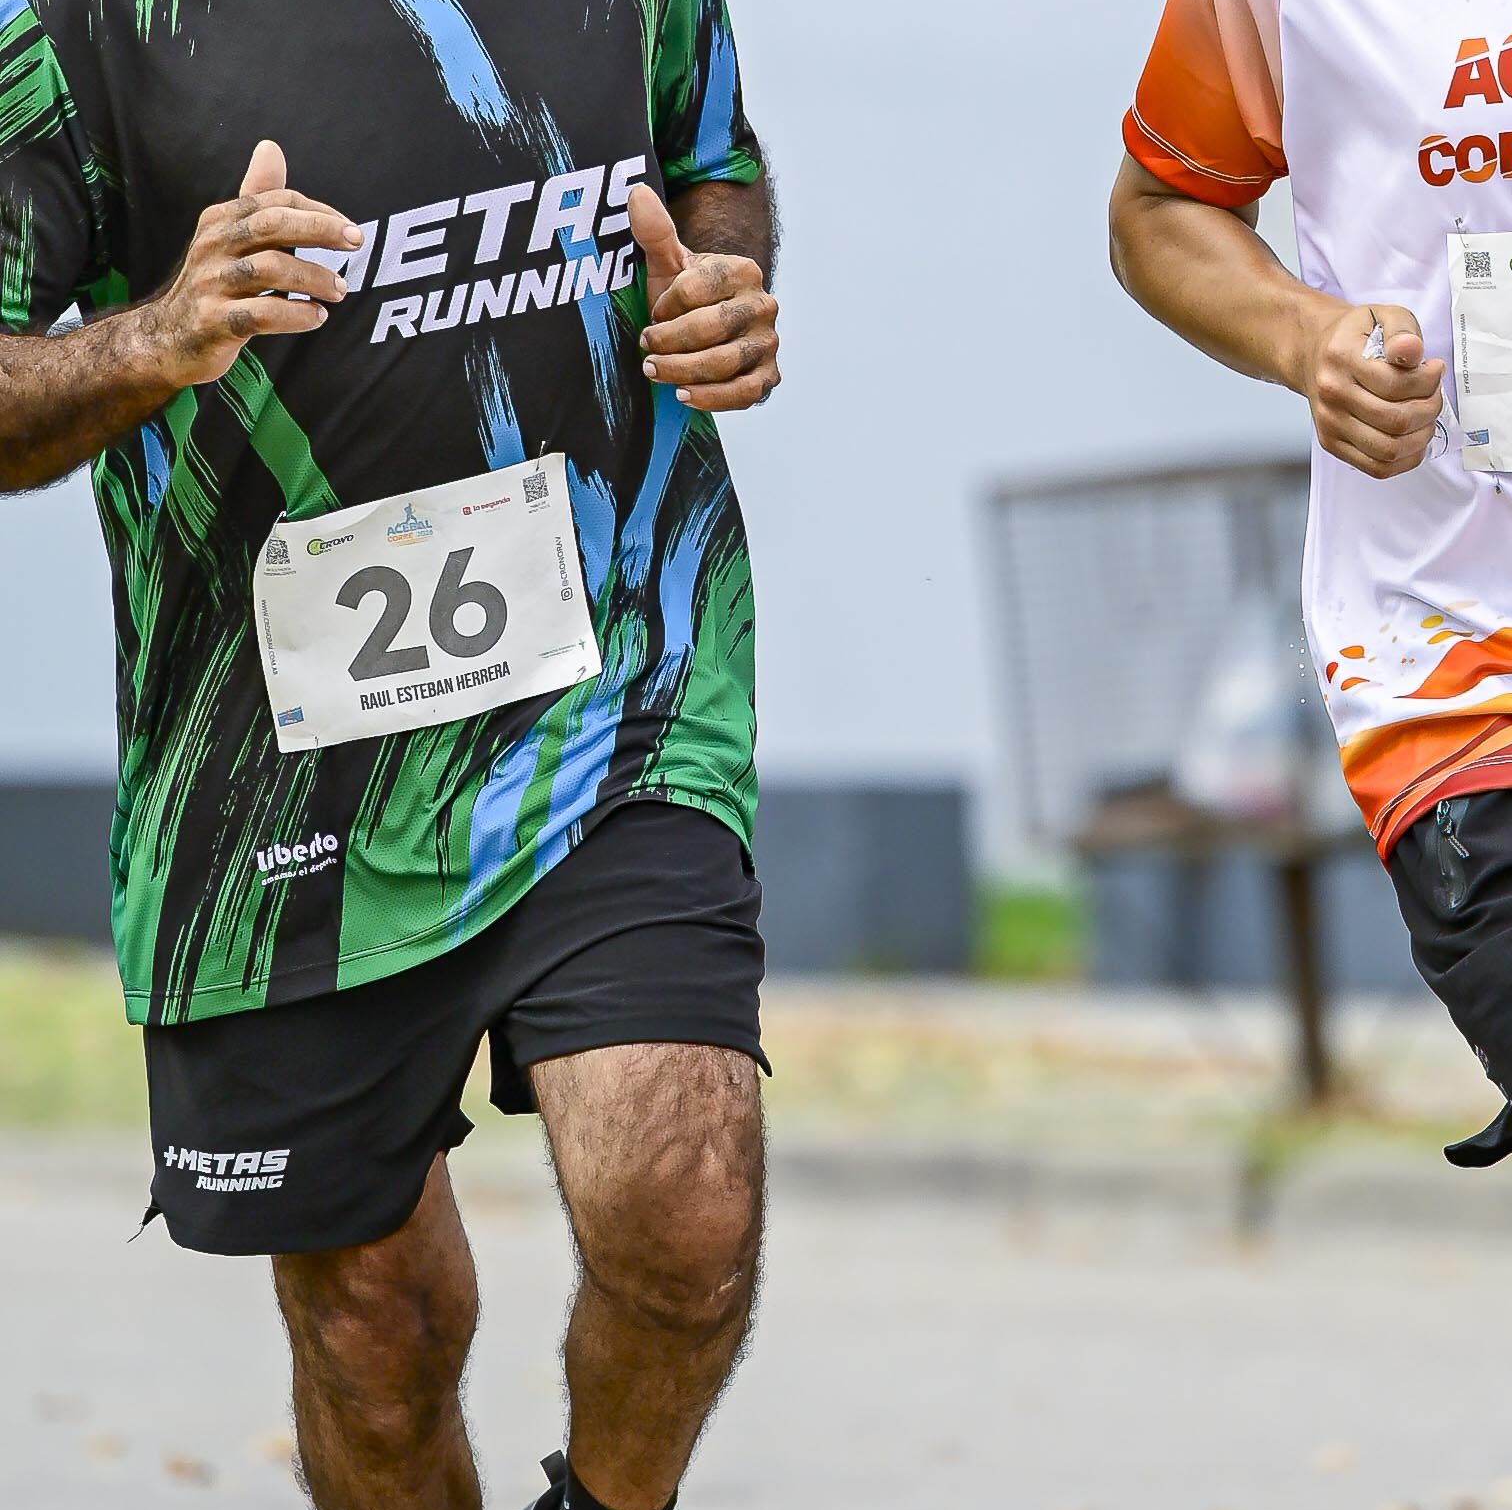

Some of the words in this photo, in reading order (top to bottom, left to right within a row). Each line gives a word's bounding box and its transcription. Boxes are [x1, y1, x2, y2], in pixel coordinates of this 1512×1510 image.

[370, 241, 634, 344] RUNNING
[387, 519, 433, 536] ACEBAL
[335, 546, 508, 681] 26
[359, 691, 395, 711] RAUL
[397, 678, 454, 704] ESTEBAN
[456, 661, 511, 691] HERRERA
[196, 1174, 285, 1192] RUNNING
